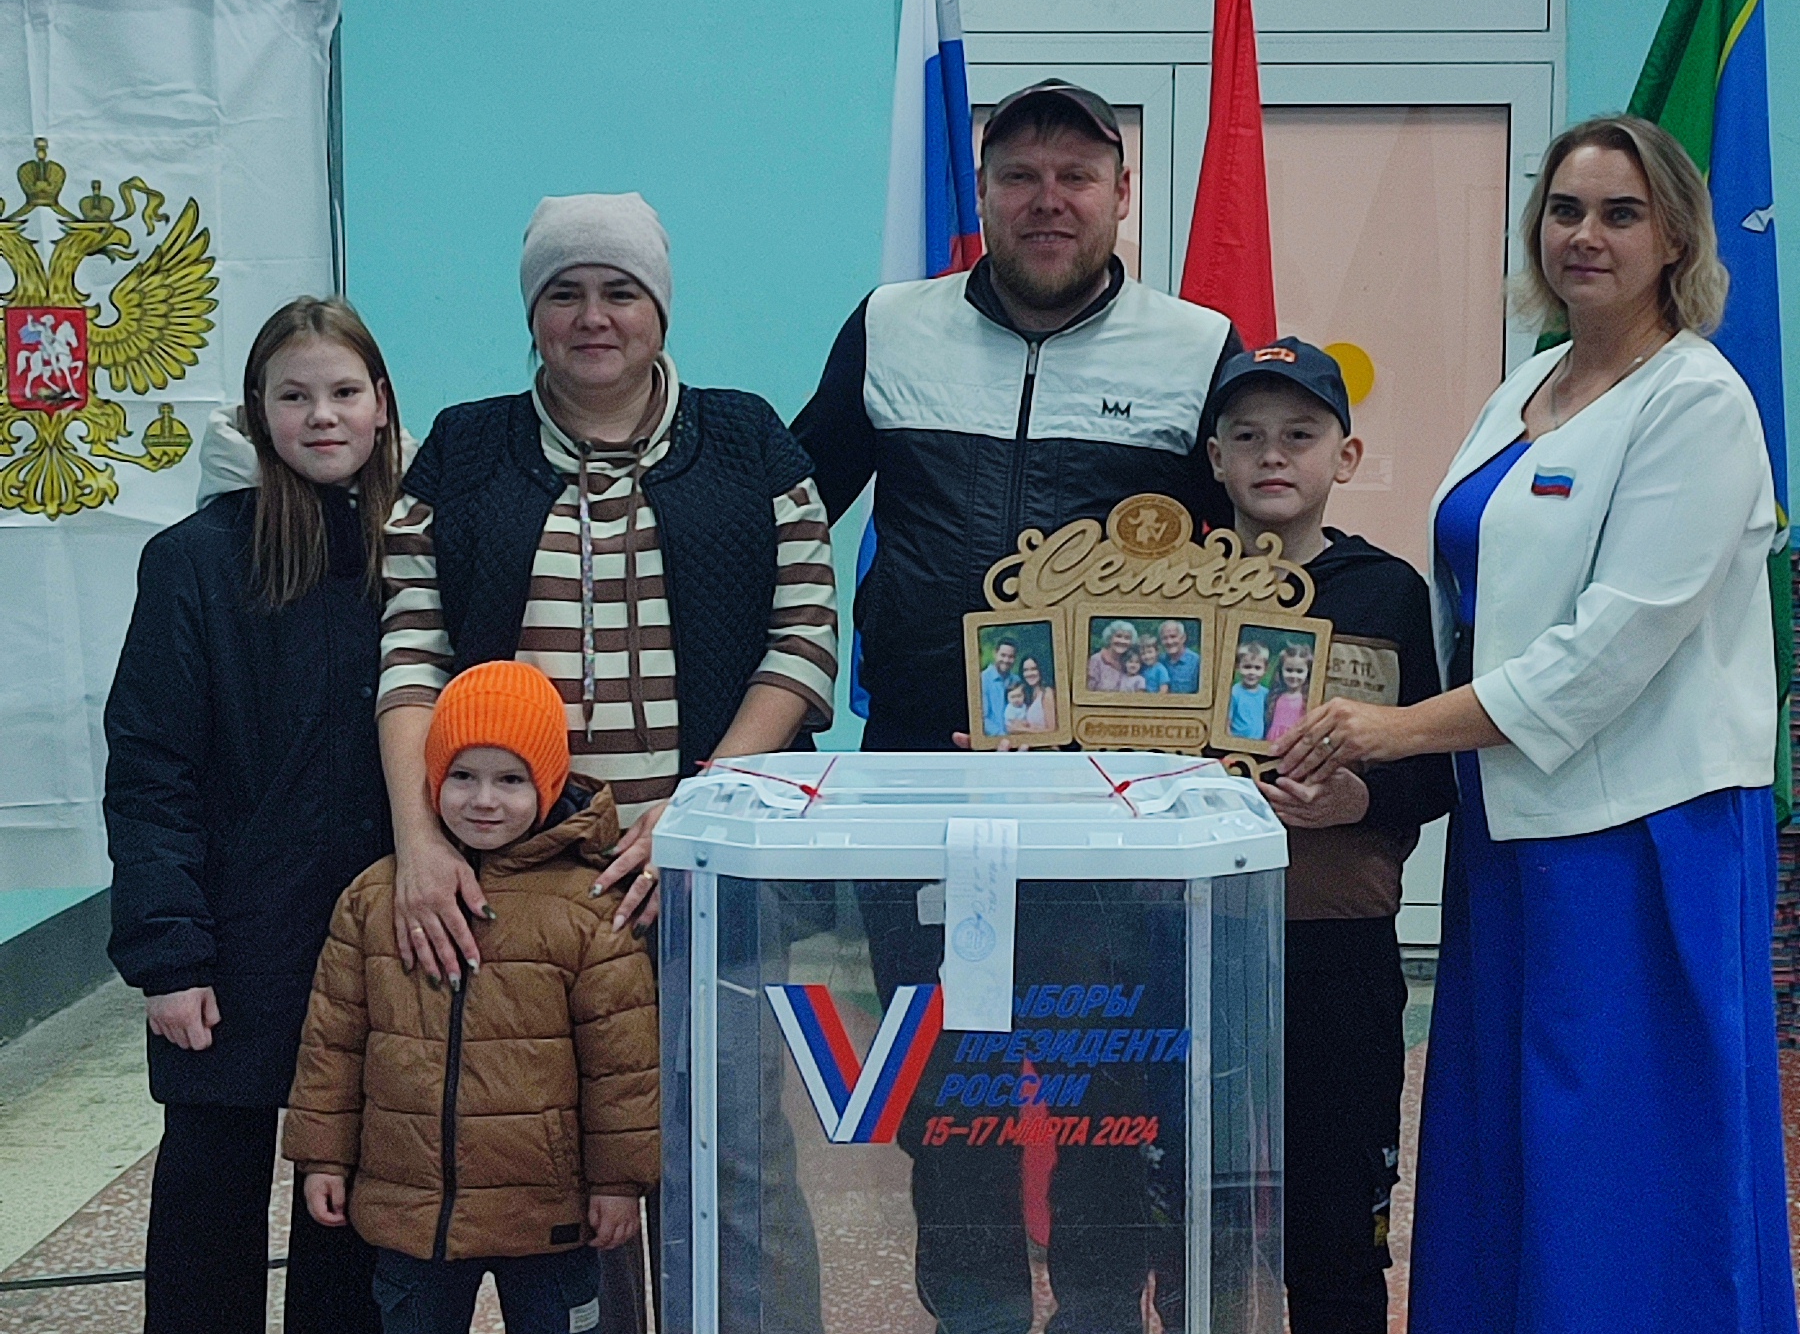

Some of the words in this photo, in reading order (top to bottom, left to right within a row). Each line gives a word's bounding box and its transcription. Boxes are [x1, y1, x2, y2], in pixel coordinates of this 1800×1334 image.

[1020, 518, 1278, 607] Семья
[1131, 724, 1200, 740] ВМЕСТЕ!
[954, 1028, 1191, 1067] ПРЕЗИДЕНТА
[934, 1073, 1091, 1107] РОССИИ
[997, 1116, 1090, 1146] МАРТА
[1091, 1116, 1159, 1146] 2024
